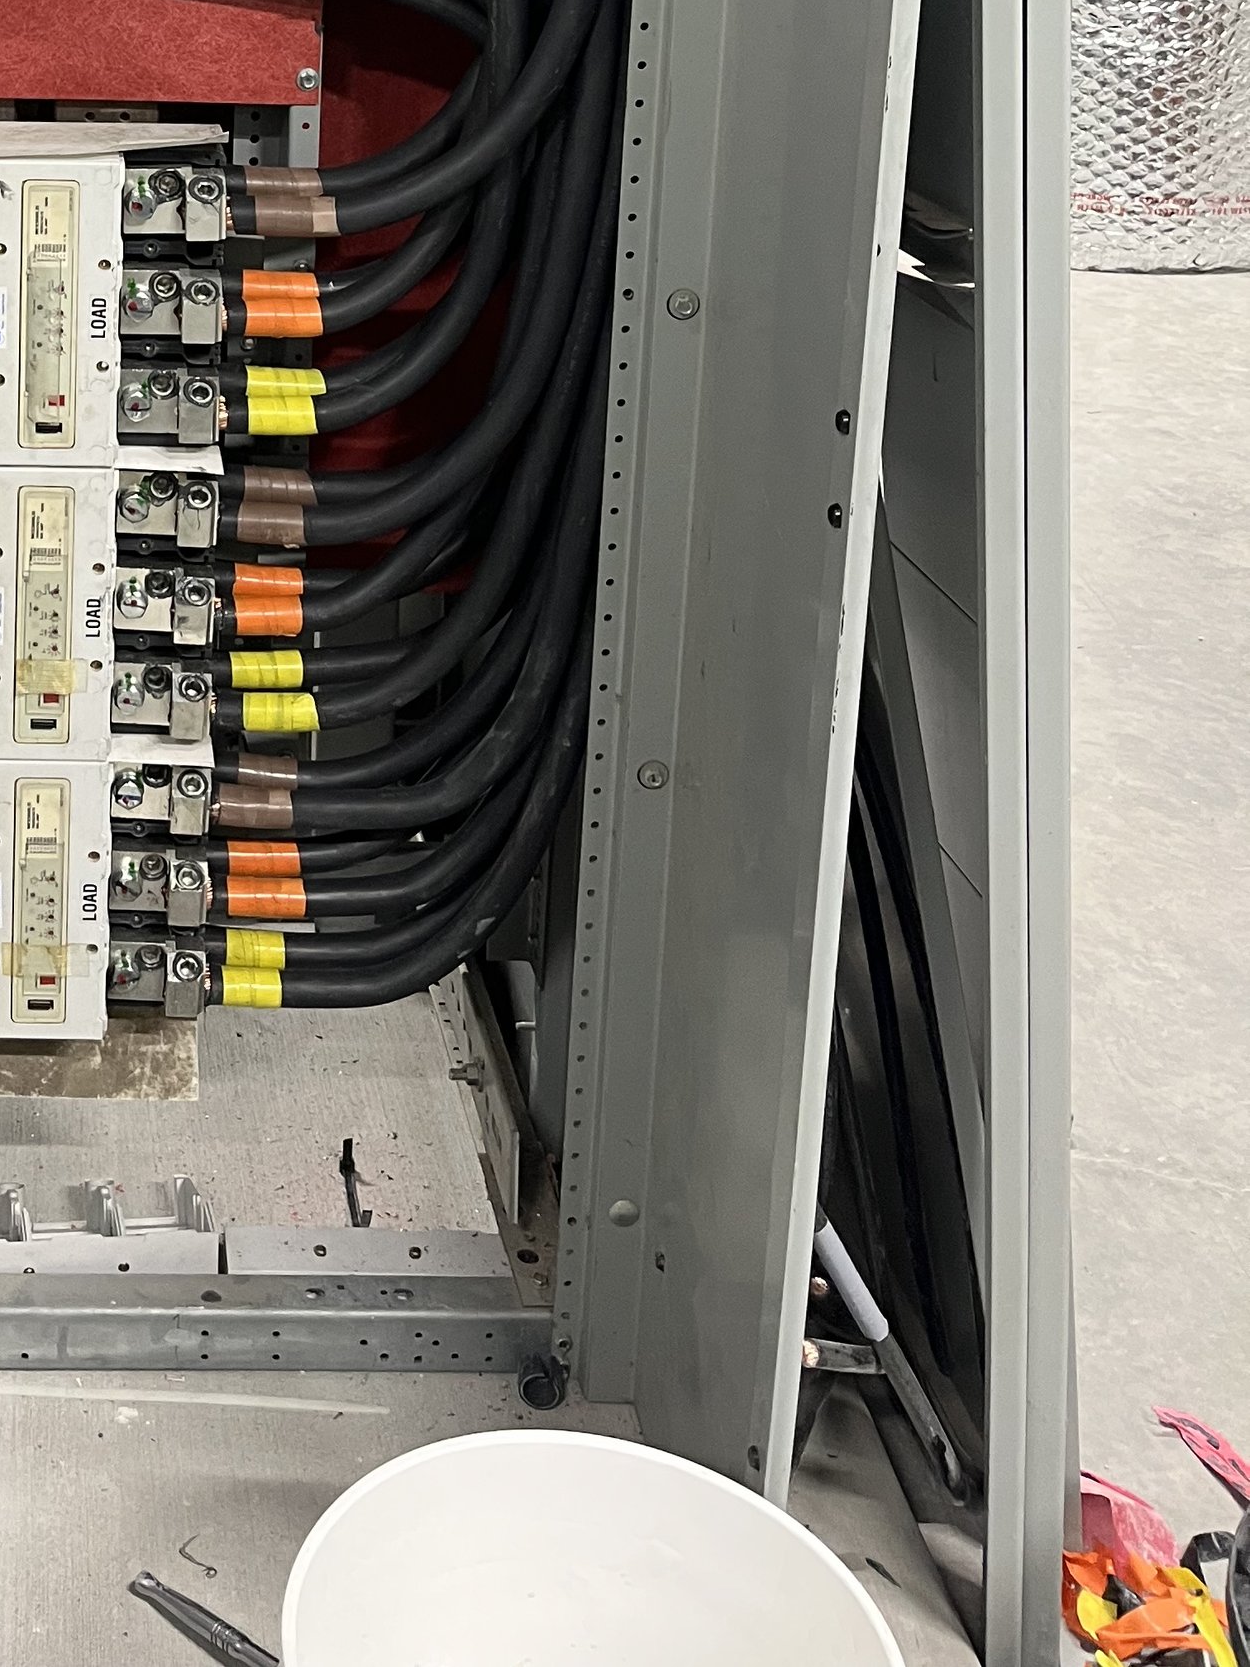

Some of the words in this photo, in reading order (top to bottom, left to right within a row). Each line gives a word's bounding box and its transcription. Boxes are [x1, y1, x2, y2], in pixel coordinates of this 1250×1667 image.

[90, 297, 107, 339] LOAD
[85, 597, 102, 638] LOAD
[82, 883, 98, 921] LOAD
